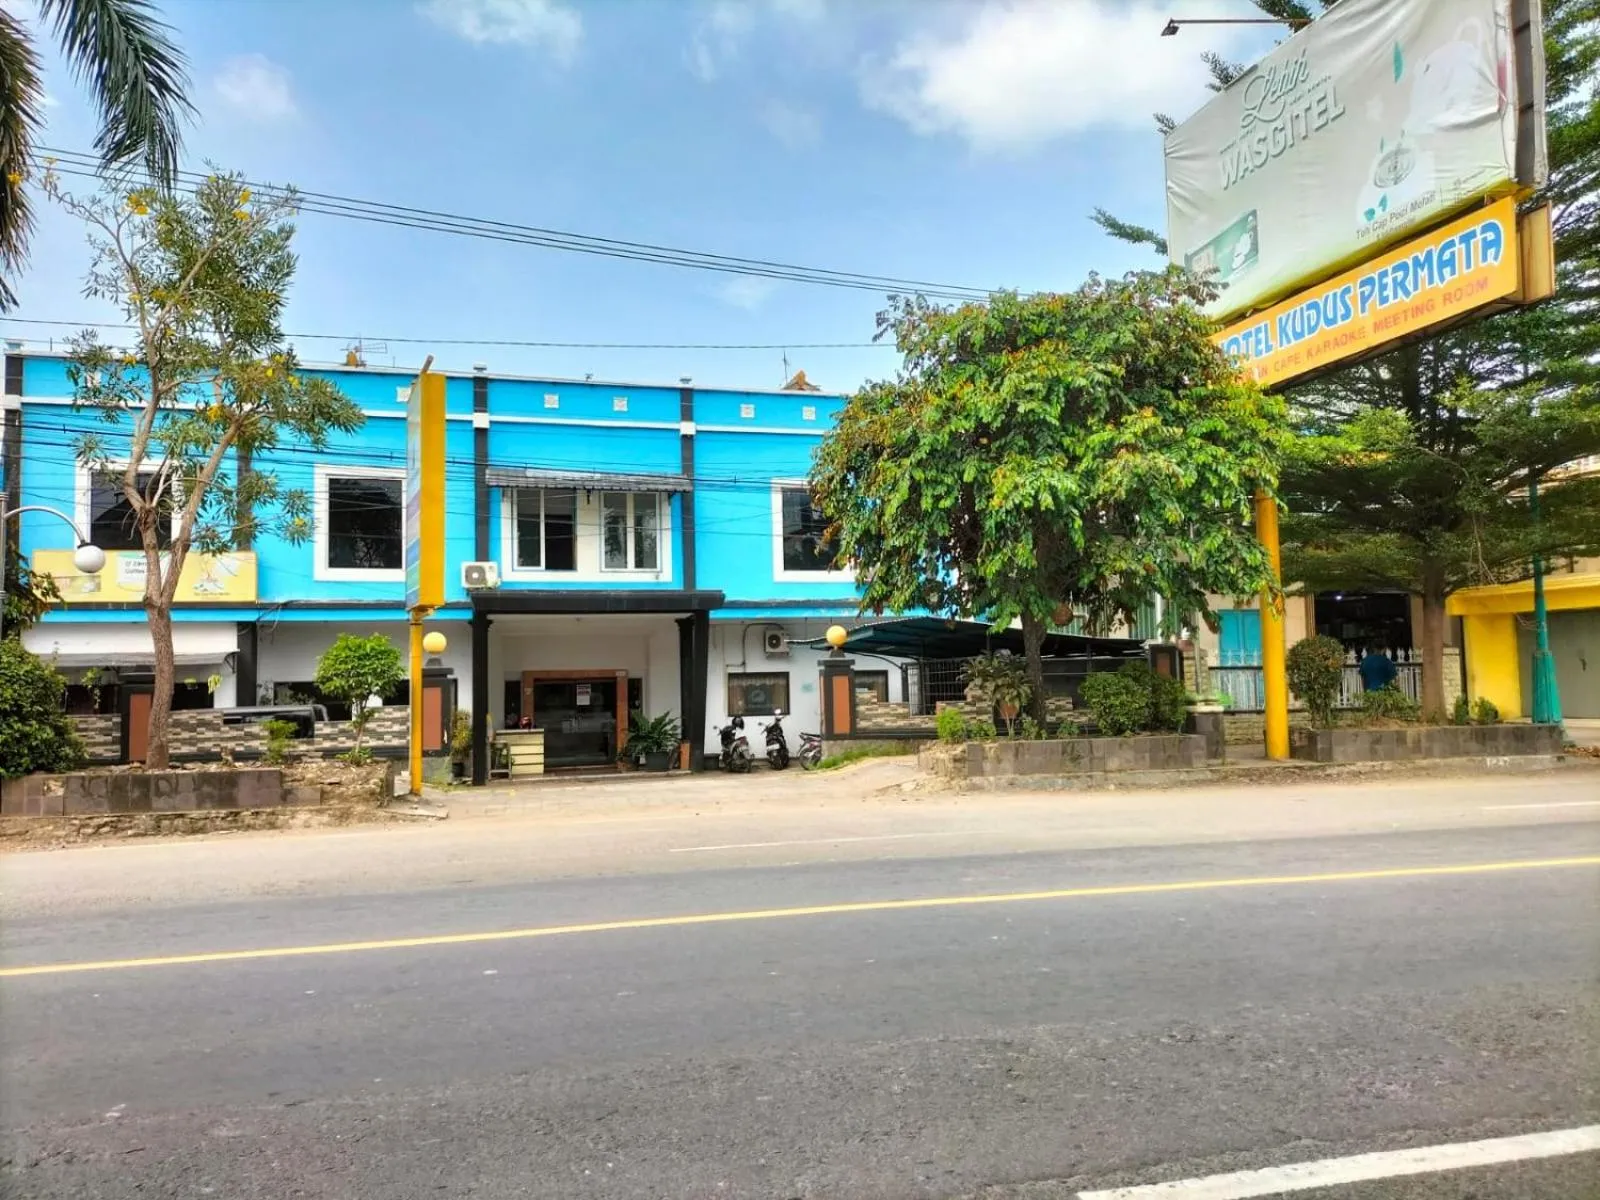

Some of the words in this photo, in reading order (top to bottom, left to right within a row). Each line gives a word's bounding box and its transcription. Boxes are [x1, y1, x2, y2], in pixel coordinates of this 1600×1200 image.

[1220, 82, 1346, 190] WASGITEL
[1274, 352, 1301, 372] CAFE
[1306, 326, 1366, 359] KARAOKE
[1373, 298, 1435, 334] MEETING
[1442, 276, 1489, 307] ROOM
[1277, 284, 1354, 348] KUDUS
[1358, 219, 1504, 316] PERMATA
